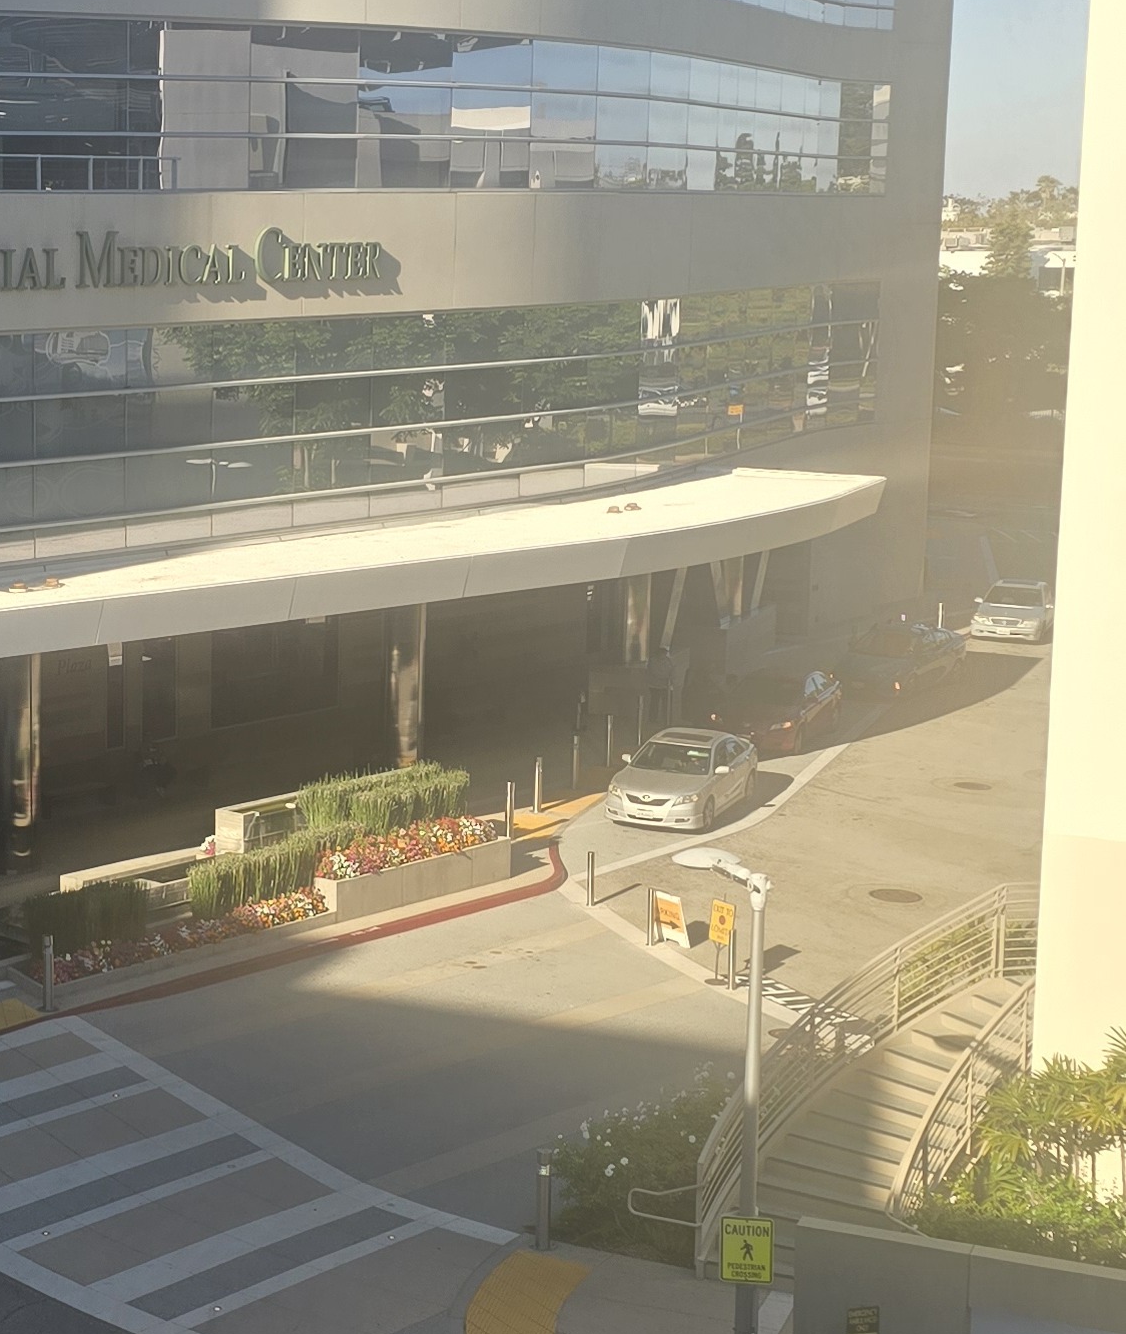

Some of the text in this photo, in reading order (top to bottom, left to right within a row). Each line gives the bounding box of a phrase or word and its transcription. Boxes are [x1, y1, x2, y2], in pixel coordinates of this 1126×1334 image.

[75, 230, 247, 289] MEDICAL
[254, 226, 383, 282] CENTER
[725, 1223, 770, 1238] CAUTION
[727, 1262, 766, 1271] PEDESTRIAN
[731, 1270, 763, 1279] CROSSING
